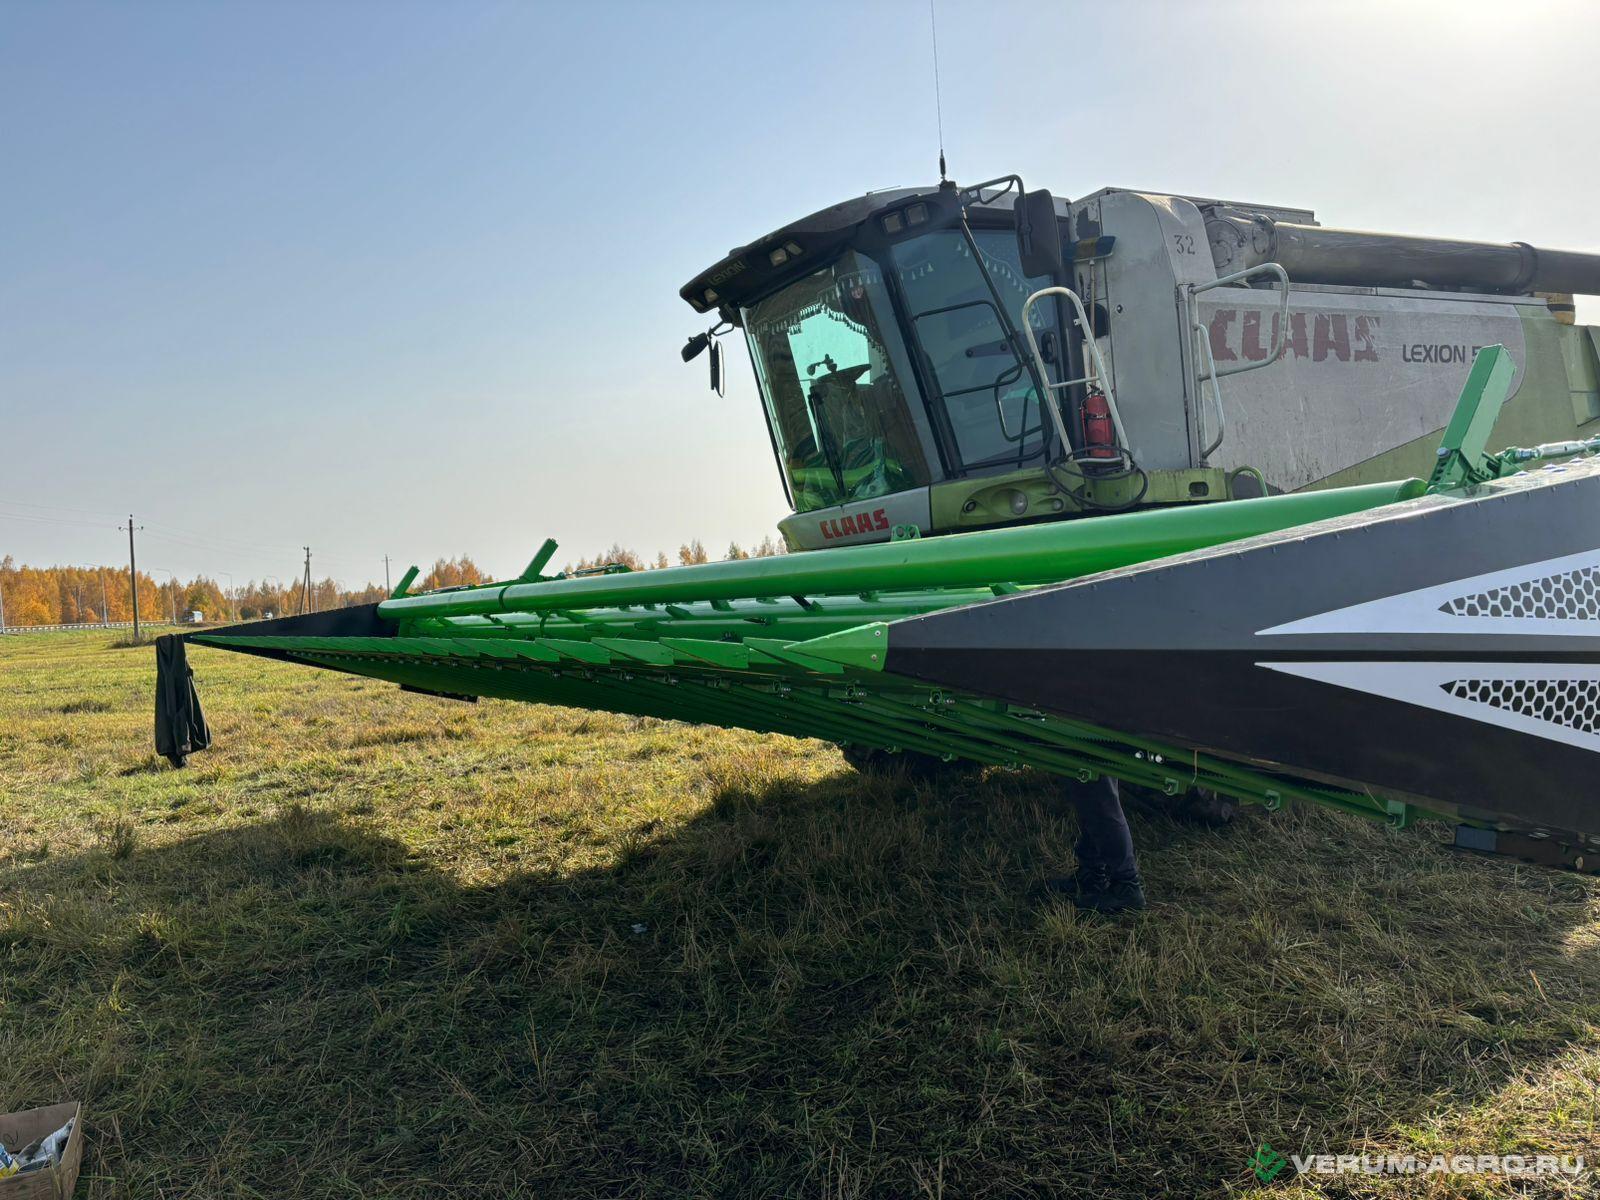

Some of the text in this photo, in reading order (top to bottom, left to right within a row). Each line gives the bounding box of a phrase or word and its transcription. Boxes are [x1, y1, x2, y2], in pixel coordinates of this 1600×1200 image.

[1173, 234, 1196, 255] 32
[1209, 309, 1381, 362] CLAAS
[1402, 343, 1466, 364] LEXION
[819, 508, 890, 540] CLAAS
